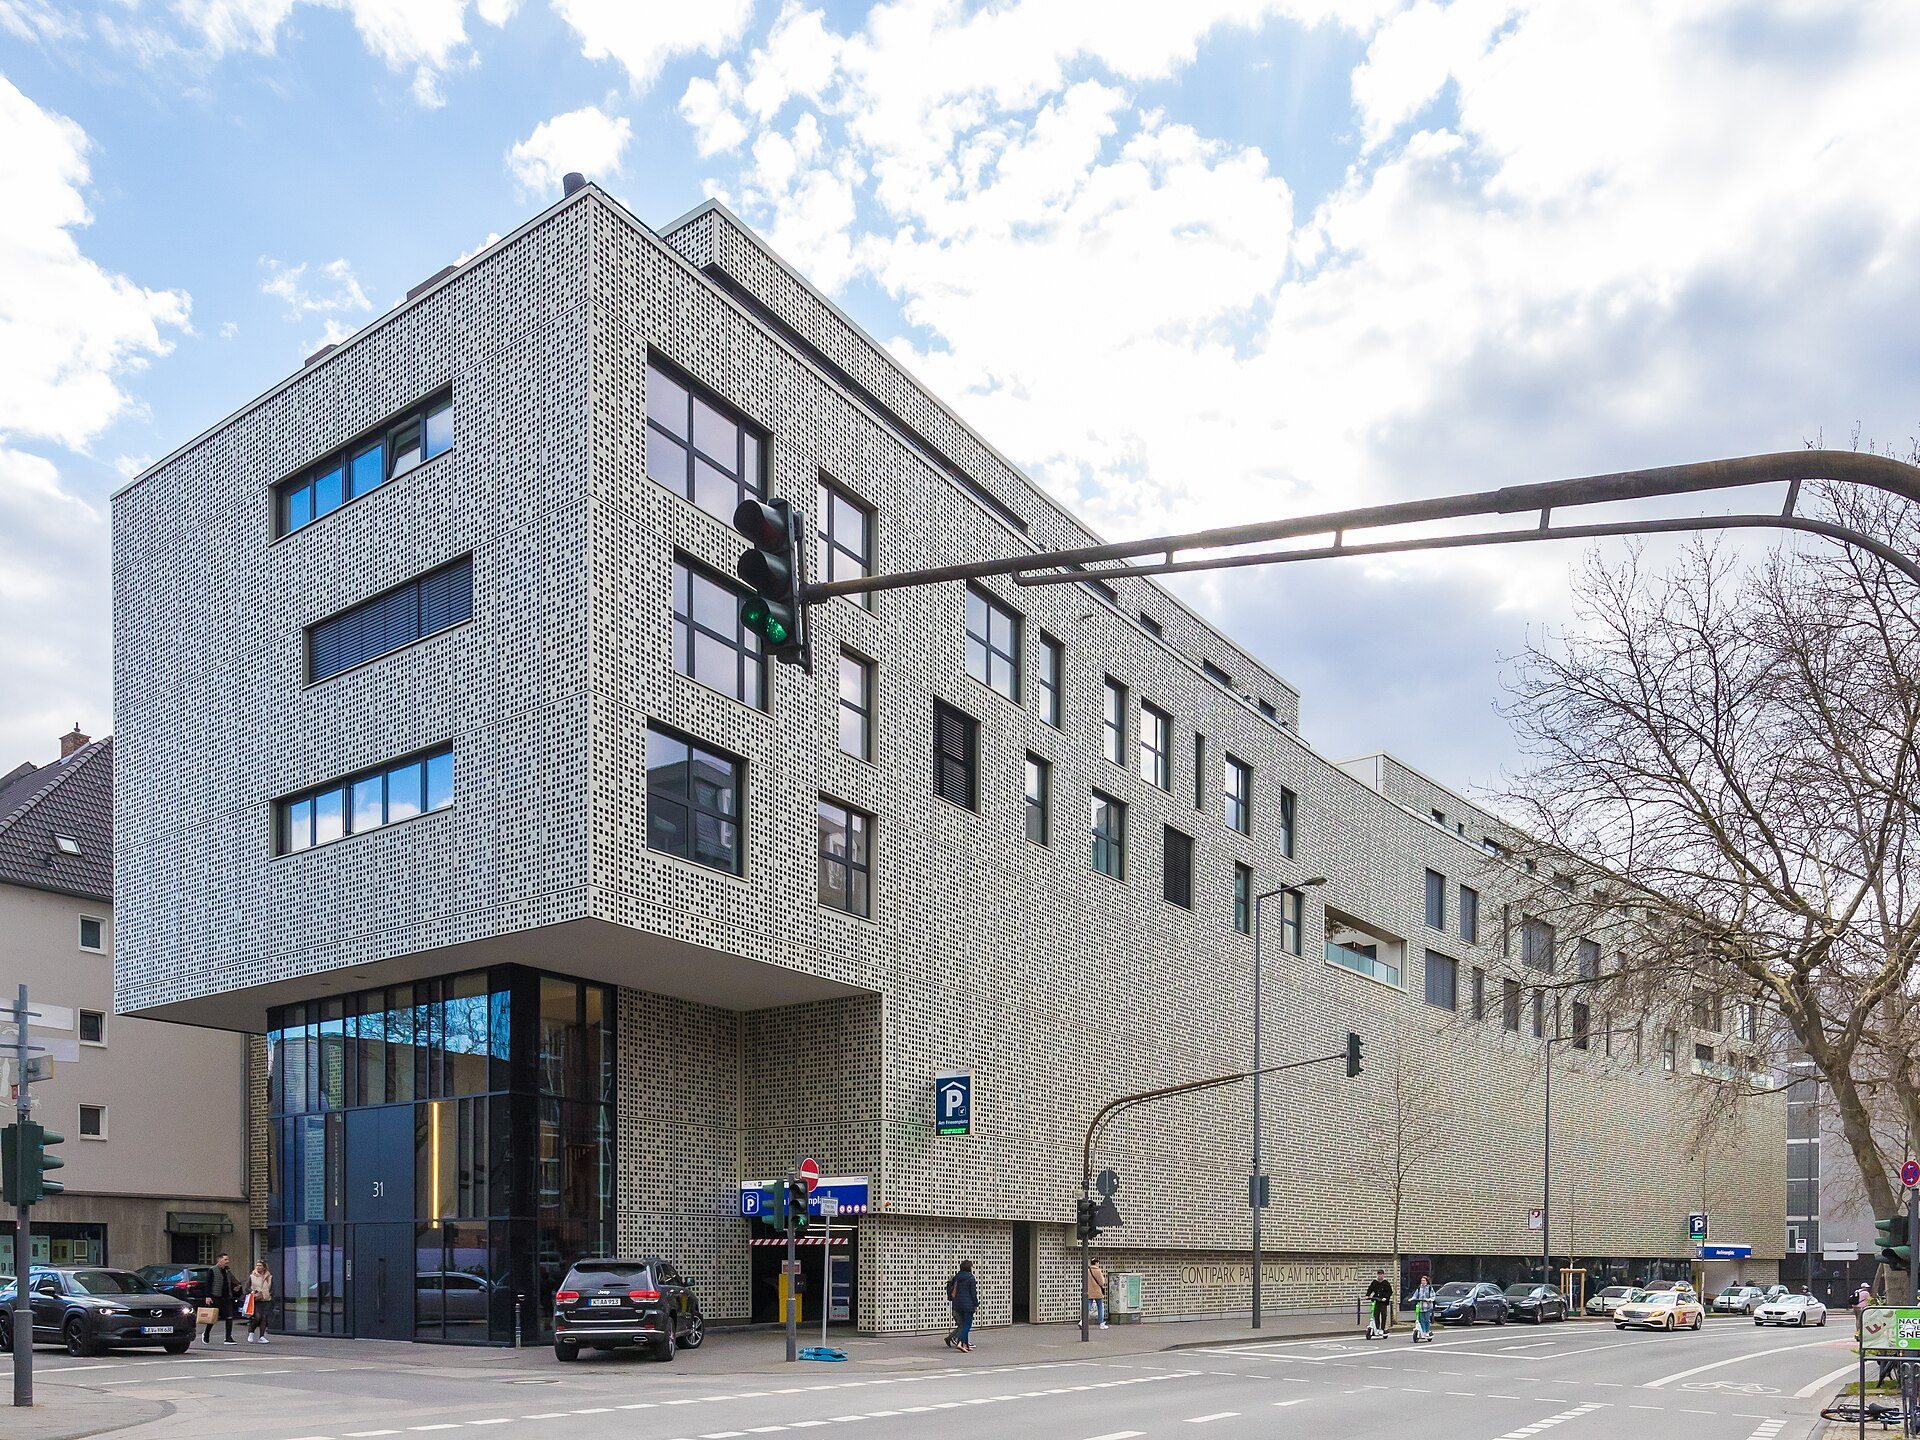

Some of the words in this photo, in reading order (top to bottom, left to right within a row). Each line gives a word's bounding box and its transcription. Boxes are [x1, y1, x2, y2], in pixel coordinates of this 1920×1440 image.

[946, 1089, 963, 1117] P
[372, 1181, 384, 1198] 31
[747, 1199, 754, 1211] P
[1694, 1220, 1703, 1231] P
[1181, 1266, 1235, 1284] CONTIPARK
[1239, 1266, 1285, 1283] PAHAUS
[1287, 1266, 1302, 1282] AM
[1304, 1266, 1359, 1281] FRIESENPLATZ
